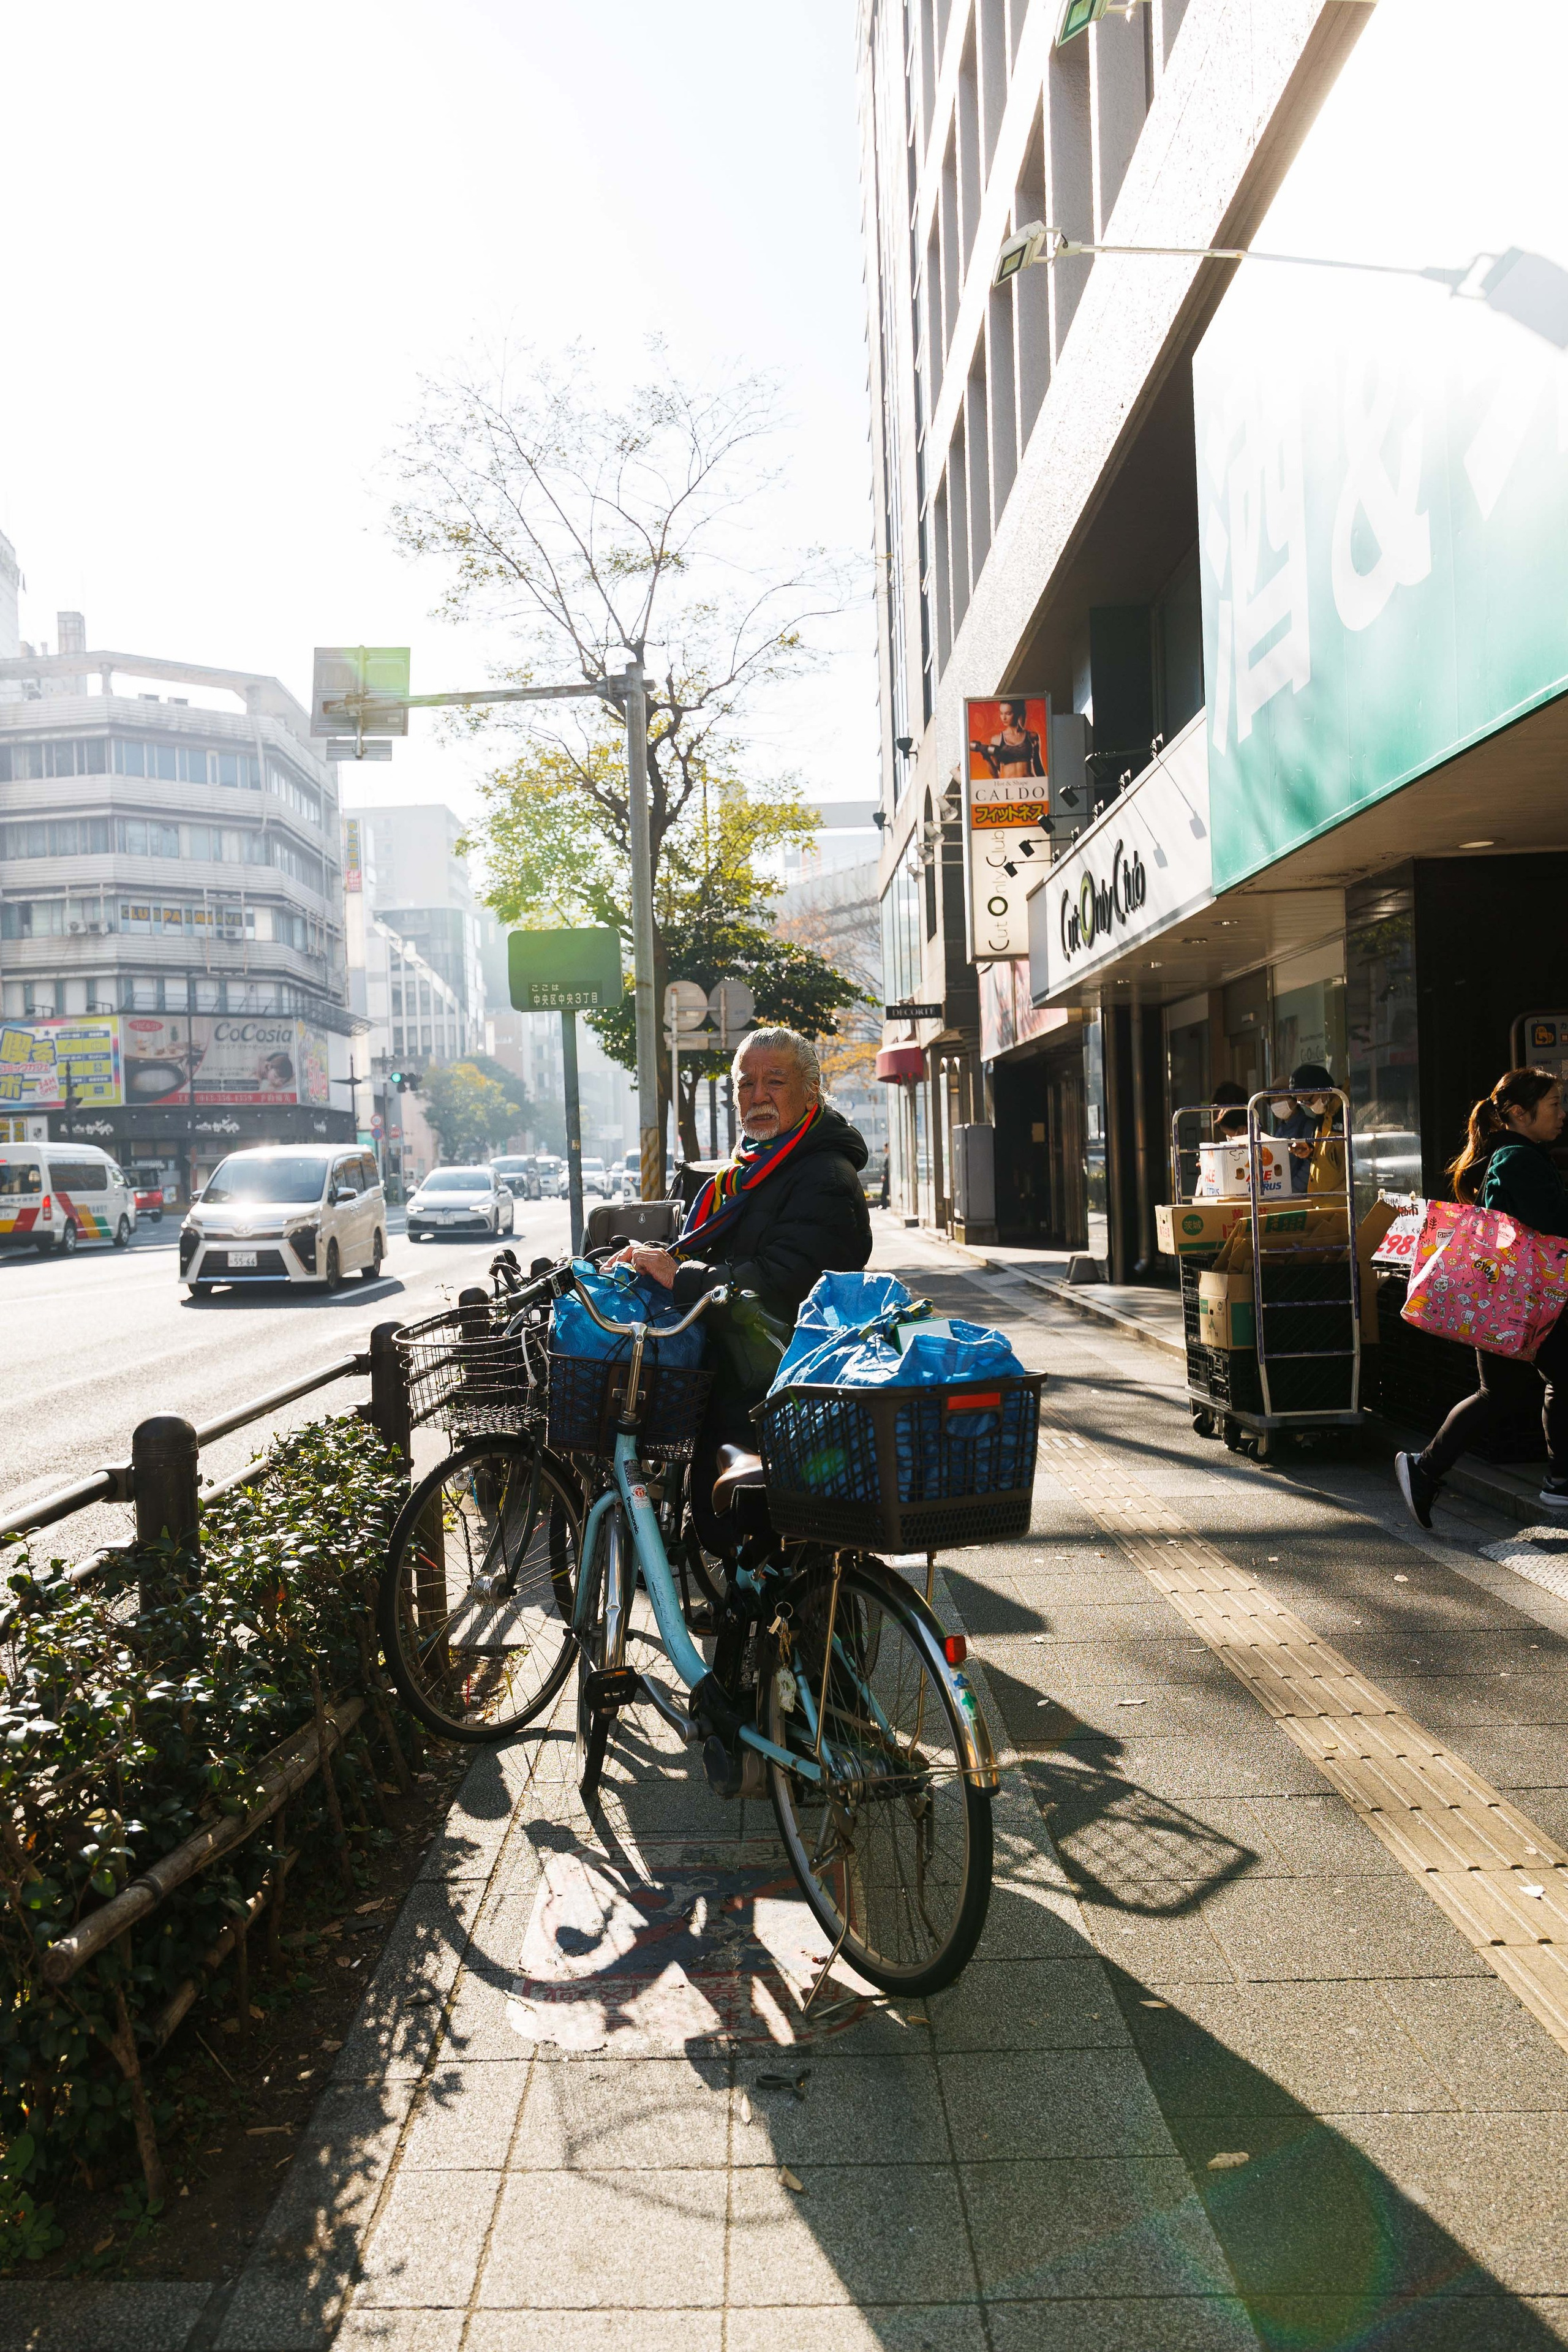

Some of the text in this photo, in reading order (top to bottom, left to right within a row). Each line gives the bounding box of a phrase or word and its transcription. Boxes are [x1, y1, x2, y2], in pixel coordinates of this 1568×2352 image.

[976, 786, 1045, 801] CALDO
[975, 804, 1044, 823] フィットネス
[986, 830, 1009, 951] Cut Only Club
[1061, 839, 1147, 963] Cut Only Club
[533, 992, 598, 1006] 中央区中央3丁目
[215, 1022, 293, 1042] CoCosia
[1474, 1260, 1498, 1284] GYOMU
[626, 1496, 639, 1535] Panasonic
